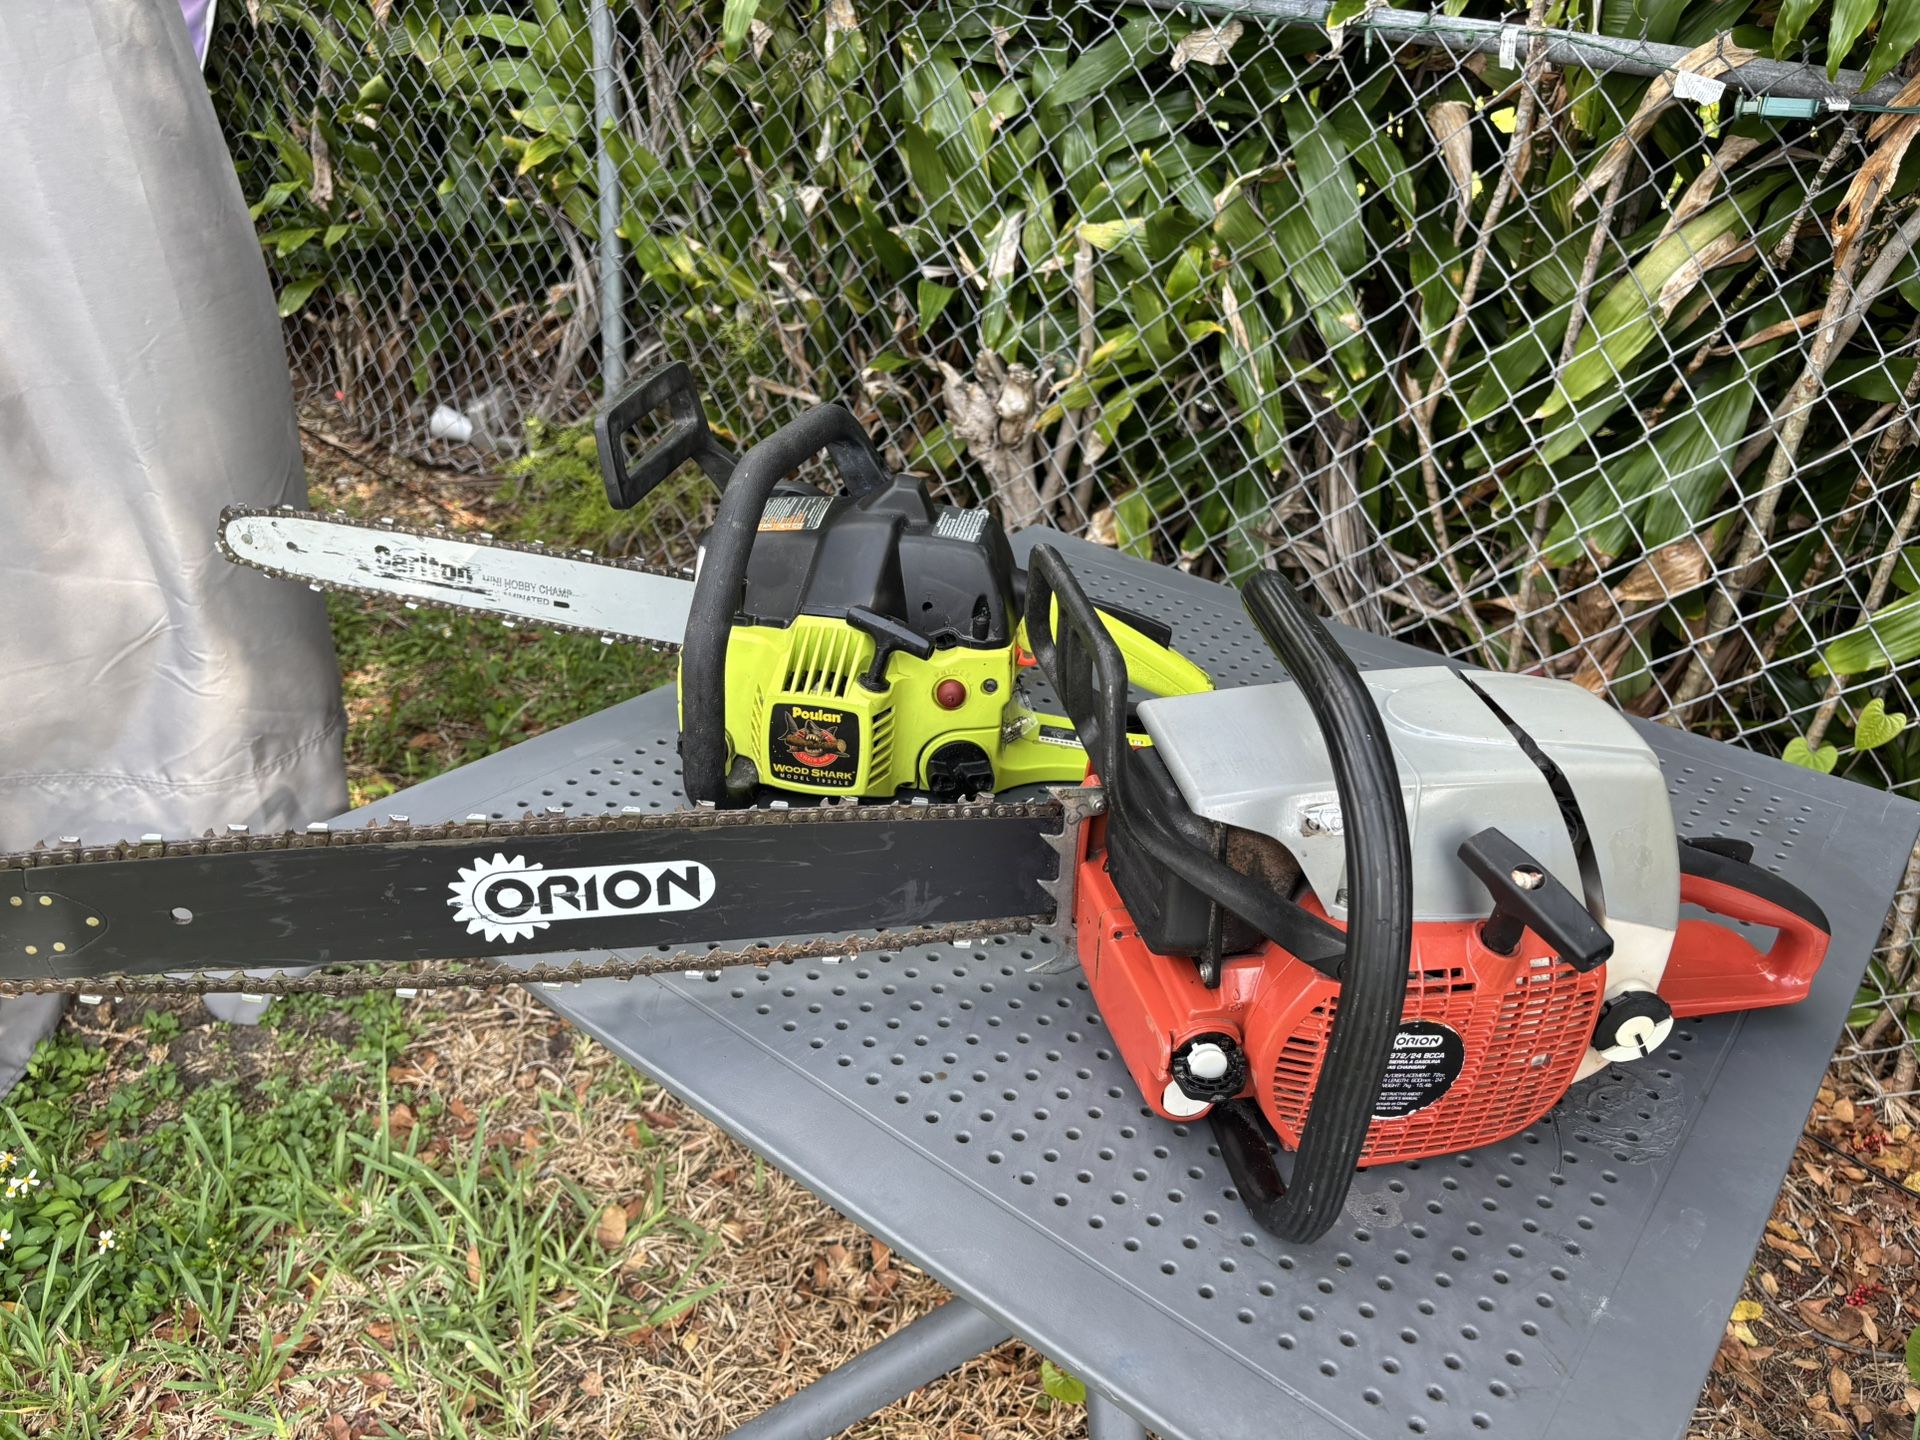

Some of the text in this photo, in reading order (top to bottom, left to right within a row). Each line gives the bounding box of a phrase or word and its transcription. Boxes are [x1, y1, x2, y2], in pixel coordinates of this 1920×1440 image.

[504, 578, 536, 593] HOBBY
[538, 584, 573, 599] CHAMP
[792, 706, 841, 724] Poulan
[773, 763, 852, 780] WOOD SHARK
[780, 773, 810, 782] MODEL
[484, 866, 701, 918] ORION
[1396, 1036, 1440, 1046] ORION
